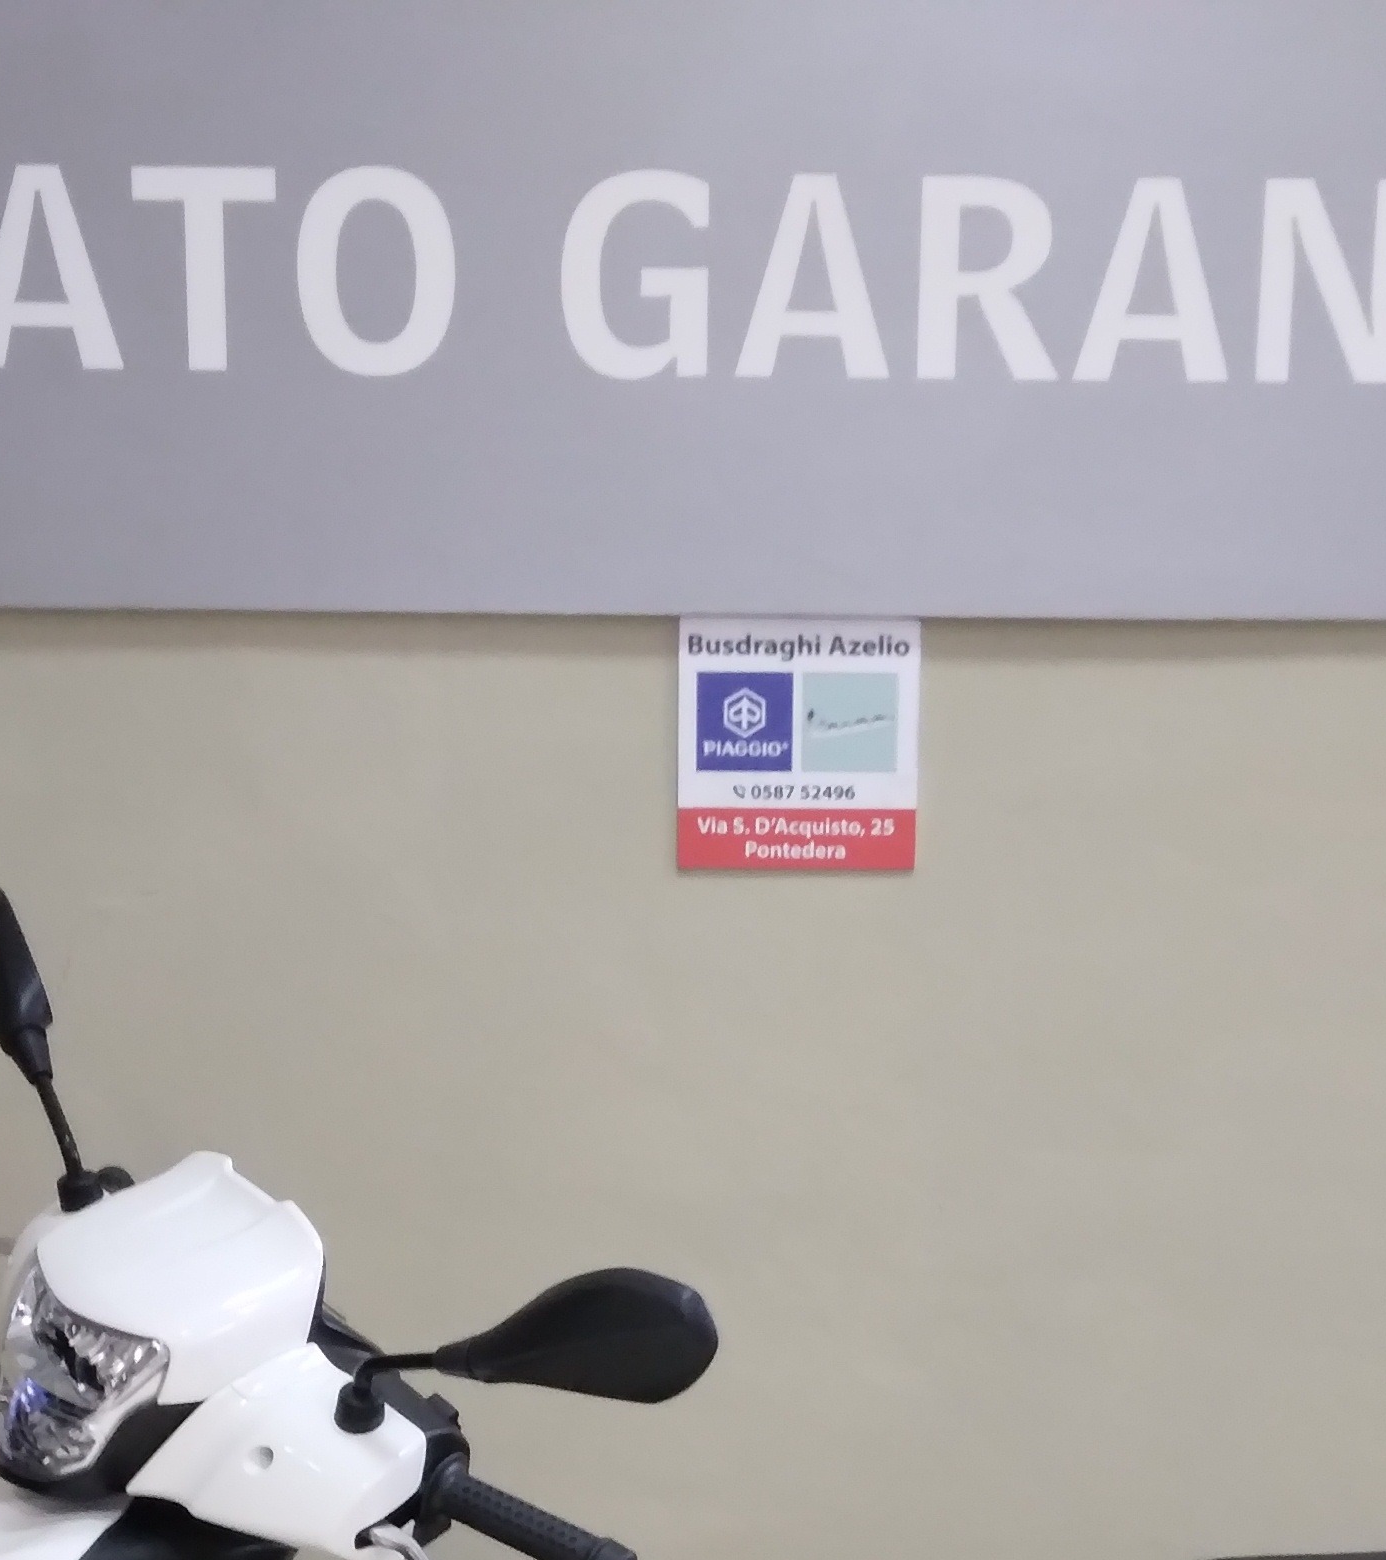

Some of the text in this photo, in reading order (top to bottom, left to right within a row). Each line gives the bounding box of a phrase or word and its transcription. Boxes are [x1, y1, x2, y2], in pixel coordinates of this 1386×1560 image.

[687, 634, 911, 661] Busdraghi Azelio
[750, 784, 856, 800] 0587 52496
[696, 817, 895, 839] Via S. D'Acquisto, 25
[744, 841, 846, 860] Pontedera
